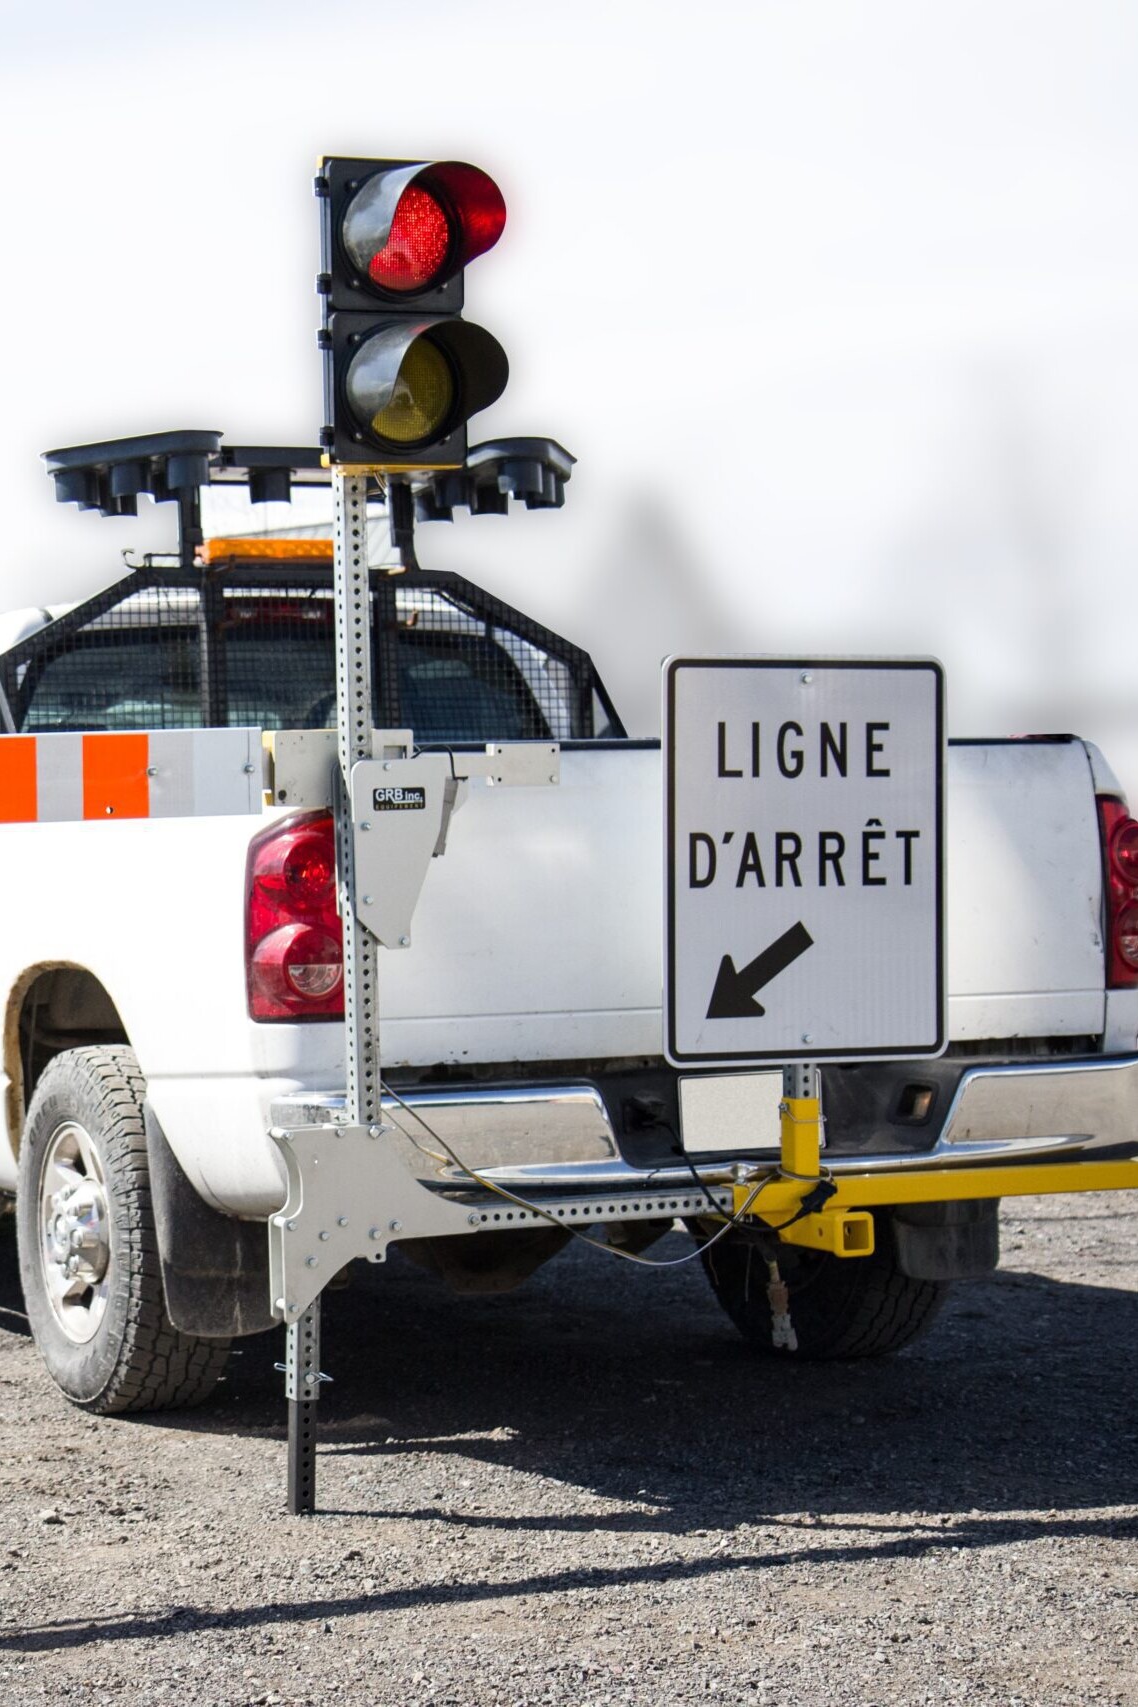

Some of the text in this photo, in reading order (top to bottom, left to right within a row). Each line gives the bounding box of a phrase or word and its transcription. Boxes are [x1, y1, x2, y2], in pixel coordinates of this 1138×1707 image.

[717, 721, 891, 779] LIGNE
[375, 788, 403, 802] GRB
[688, 818, 920, 888] D'ARRÊT
